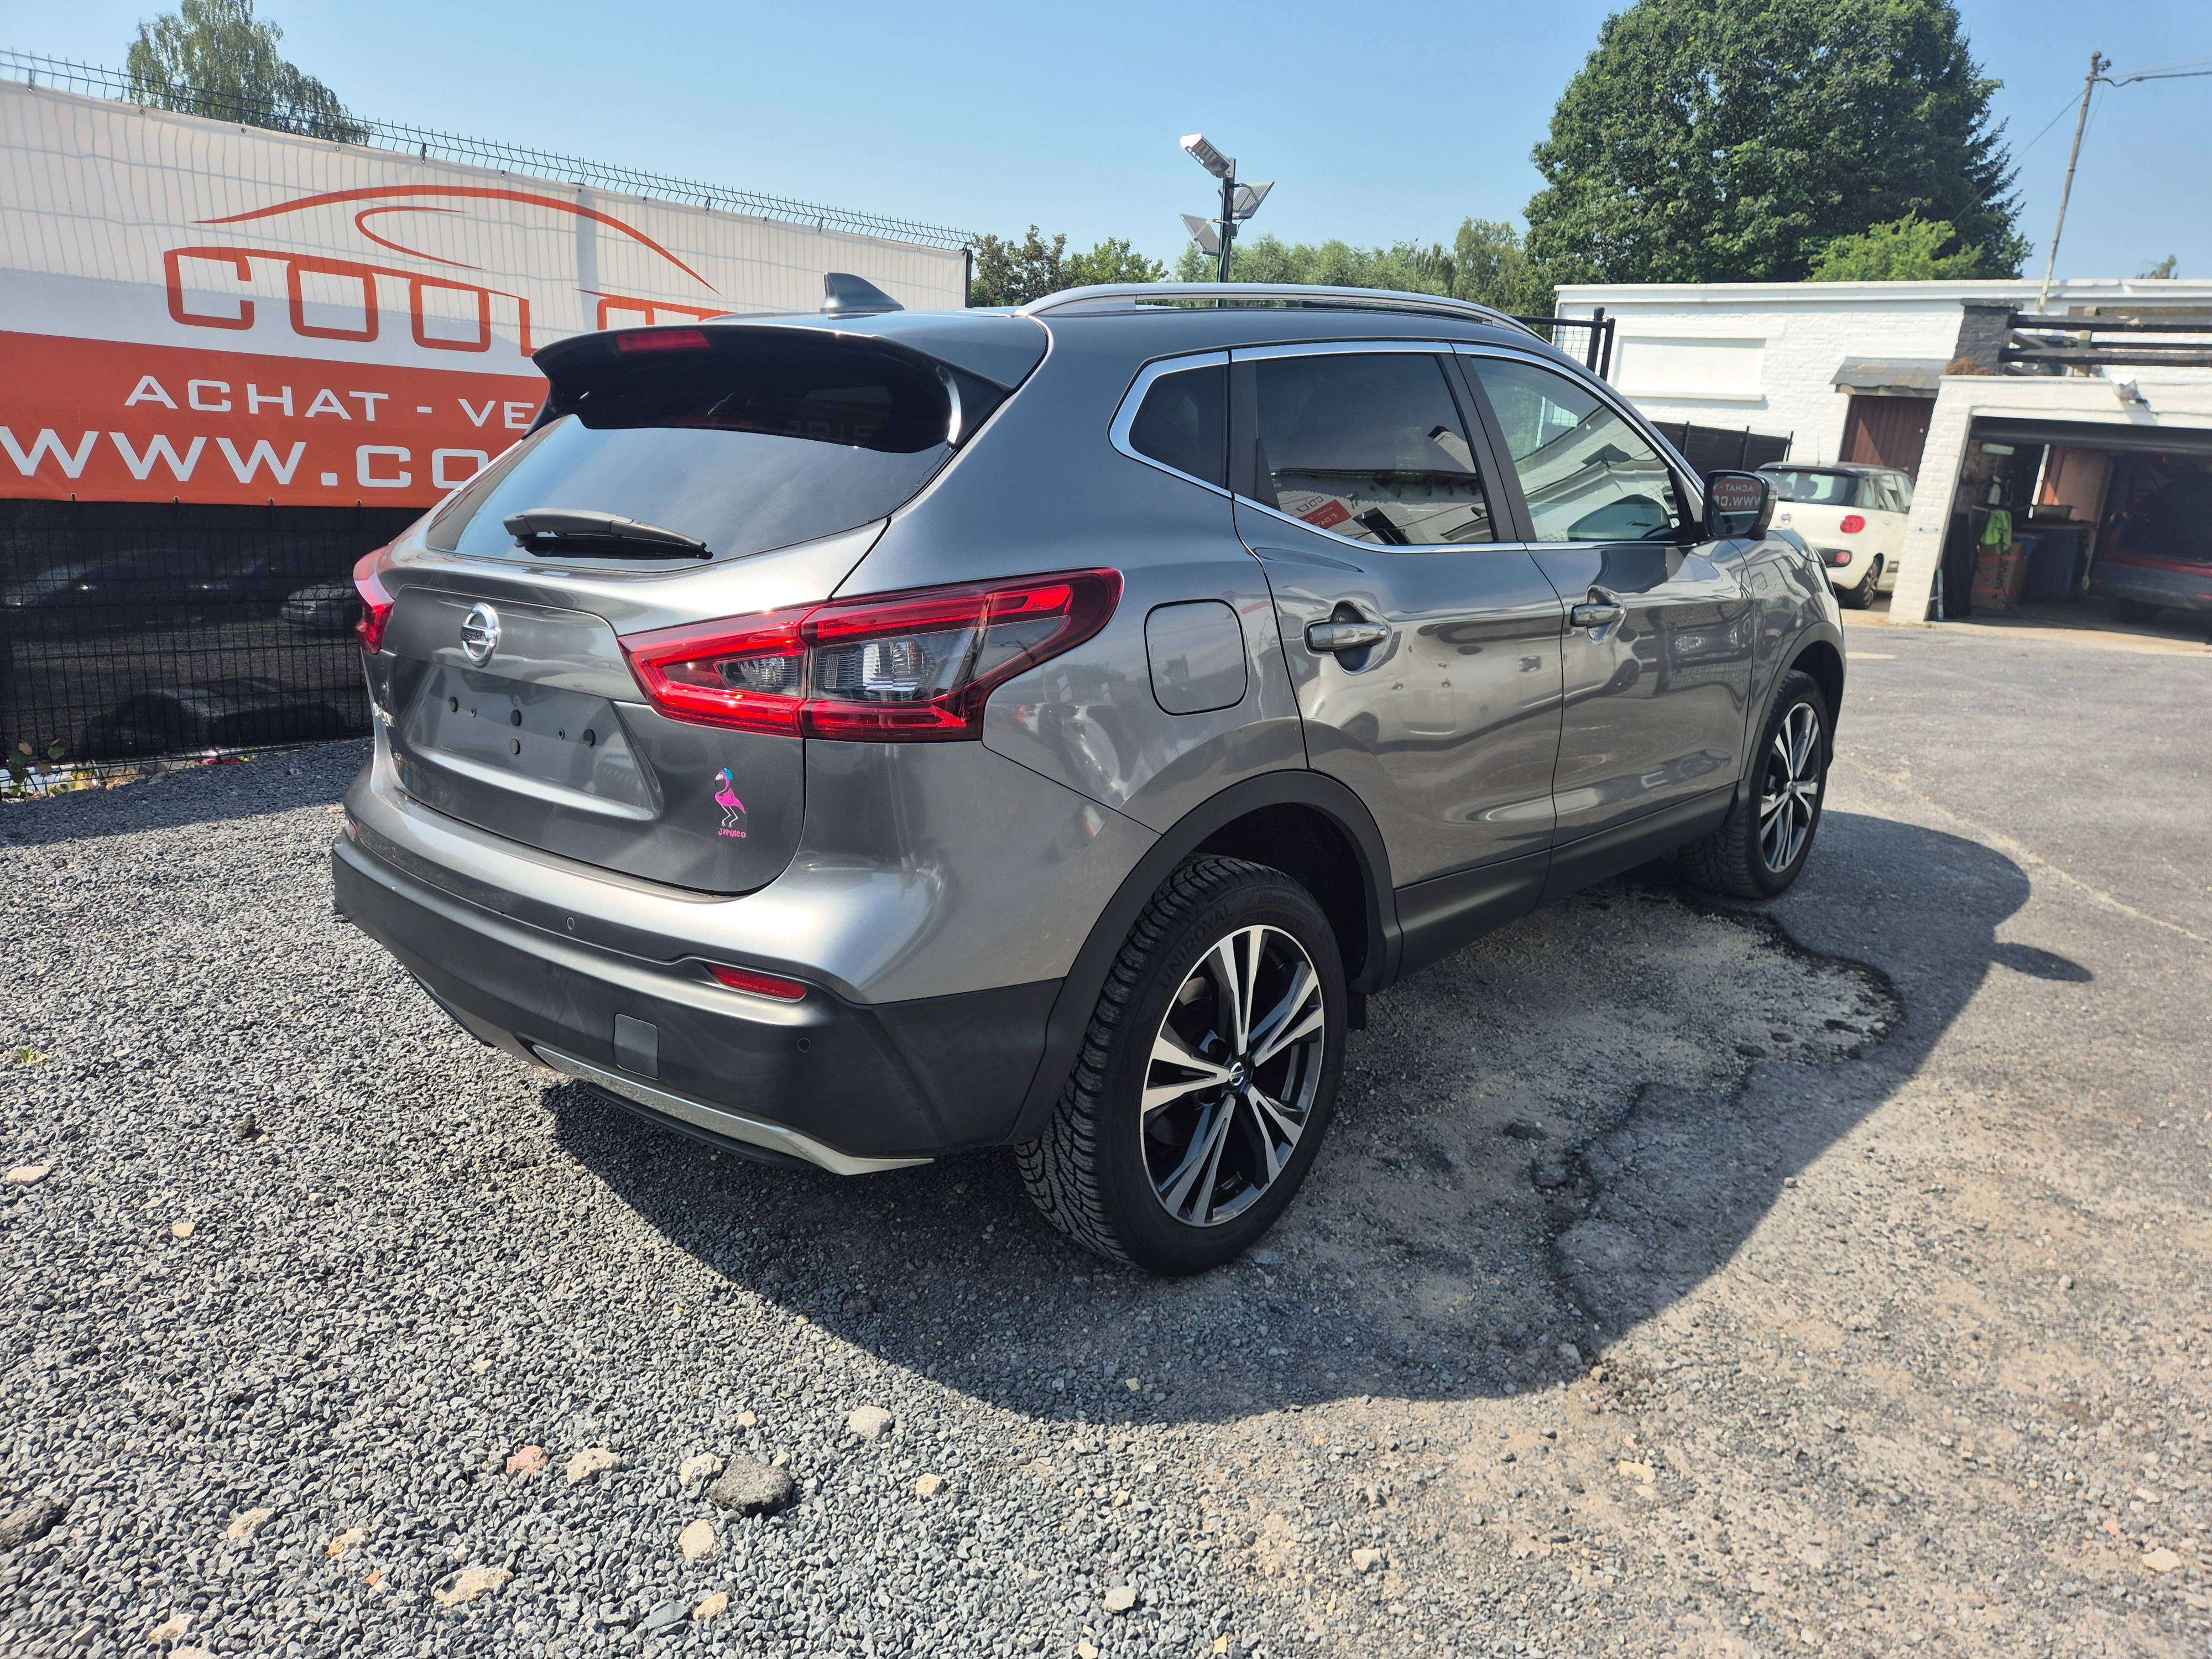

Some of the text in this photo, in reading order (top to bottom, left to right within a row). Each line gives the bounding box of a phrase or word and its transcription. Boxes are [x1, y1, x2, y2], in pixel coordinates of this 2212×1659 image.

[124, 375, 389, 422] ACHAT
[457, 398, 534, 429] VE
[1157, 904, 1234, 989] UNIROYAL
